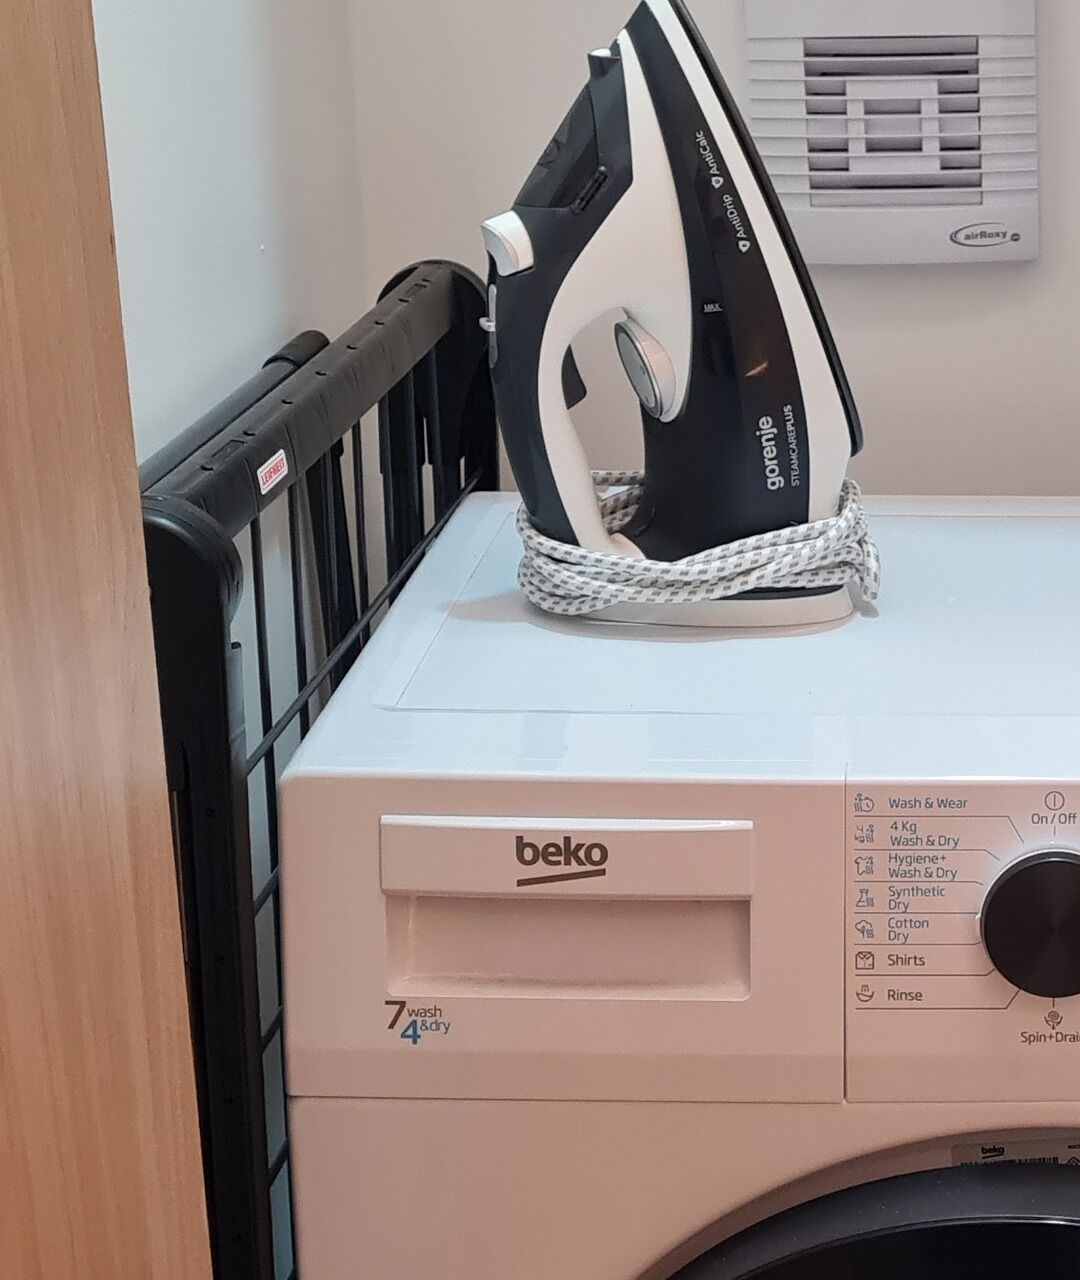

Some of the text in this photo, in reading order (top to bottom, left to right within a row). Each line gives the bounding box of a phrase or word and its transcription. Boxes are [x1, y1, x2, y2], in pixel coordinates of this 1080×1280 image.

[696, 130, 720, 175] AntiCalc
[723, 194, 747, 238] AntiDrip
[783, 404, 800, 486] STEAMCAREPLUS
[756, 416, 784, 490] gorenje
[888, 797, 968, 809] Wash & Wear
[1031, 813, 1046, 824] On
[1058, 813, 1077, 824] Off
[890, 821, 917, 835] 4 Kg
[890, 835, 959, 849] Wash & Dry
[515, 835, 609, 867] beko
[888, 852, 947, 868] Hygiene+
[888, 866, 958, 881] Wash & Dry
[888, 885, 945, 900] Synthetic
[888, 899, 909, 913] Dry
[888, 917, 929, 929] Cotton
[888, 930, 909, 944] Dry
[887, 954, 926, 966] Shirts
[887, 989, 923, 1001] Rinse
[385, 1000, 442, 1029] 7 wash
[400, 1019, 422, 1044] 4
